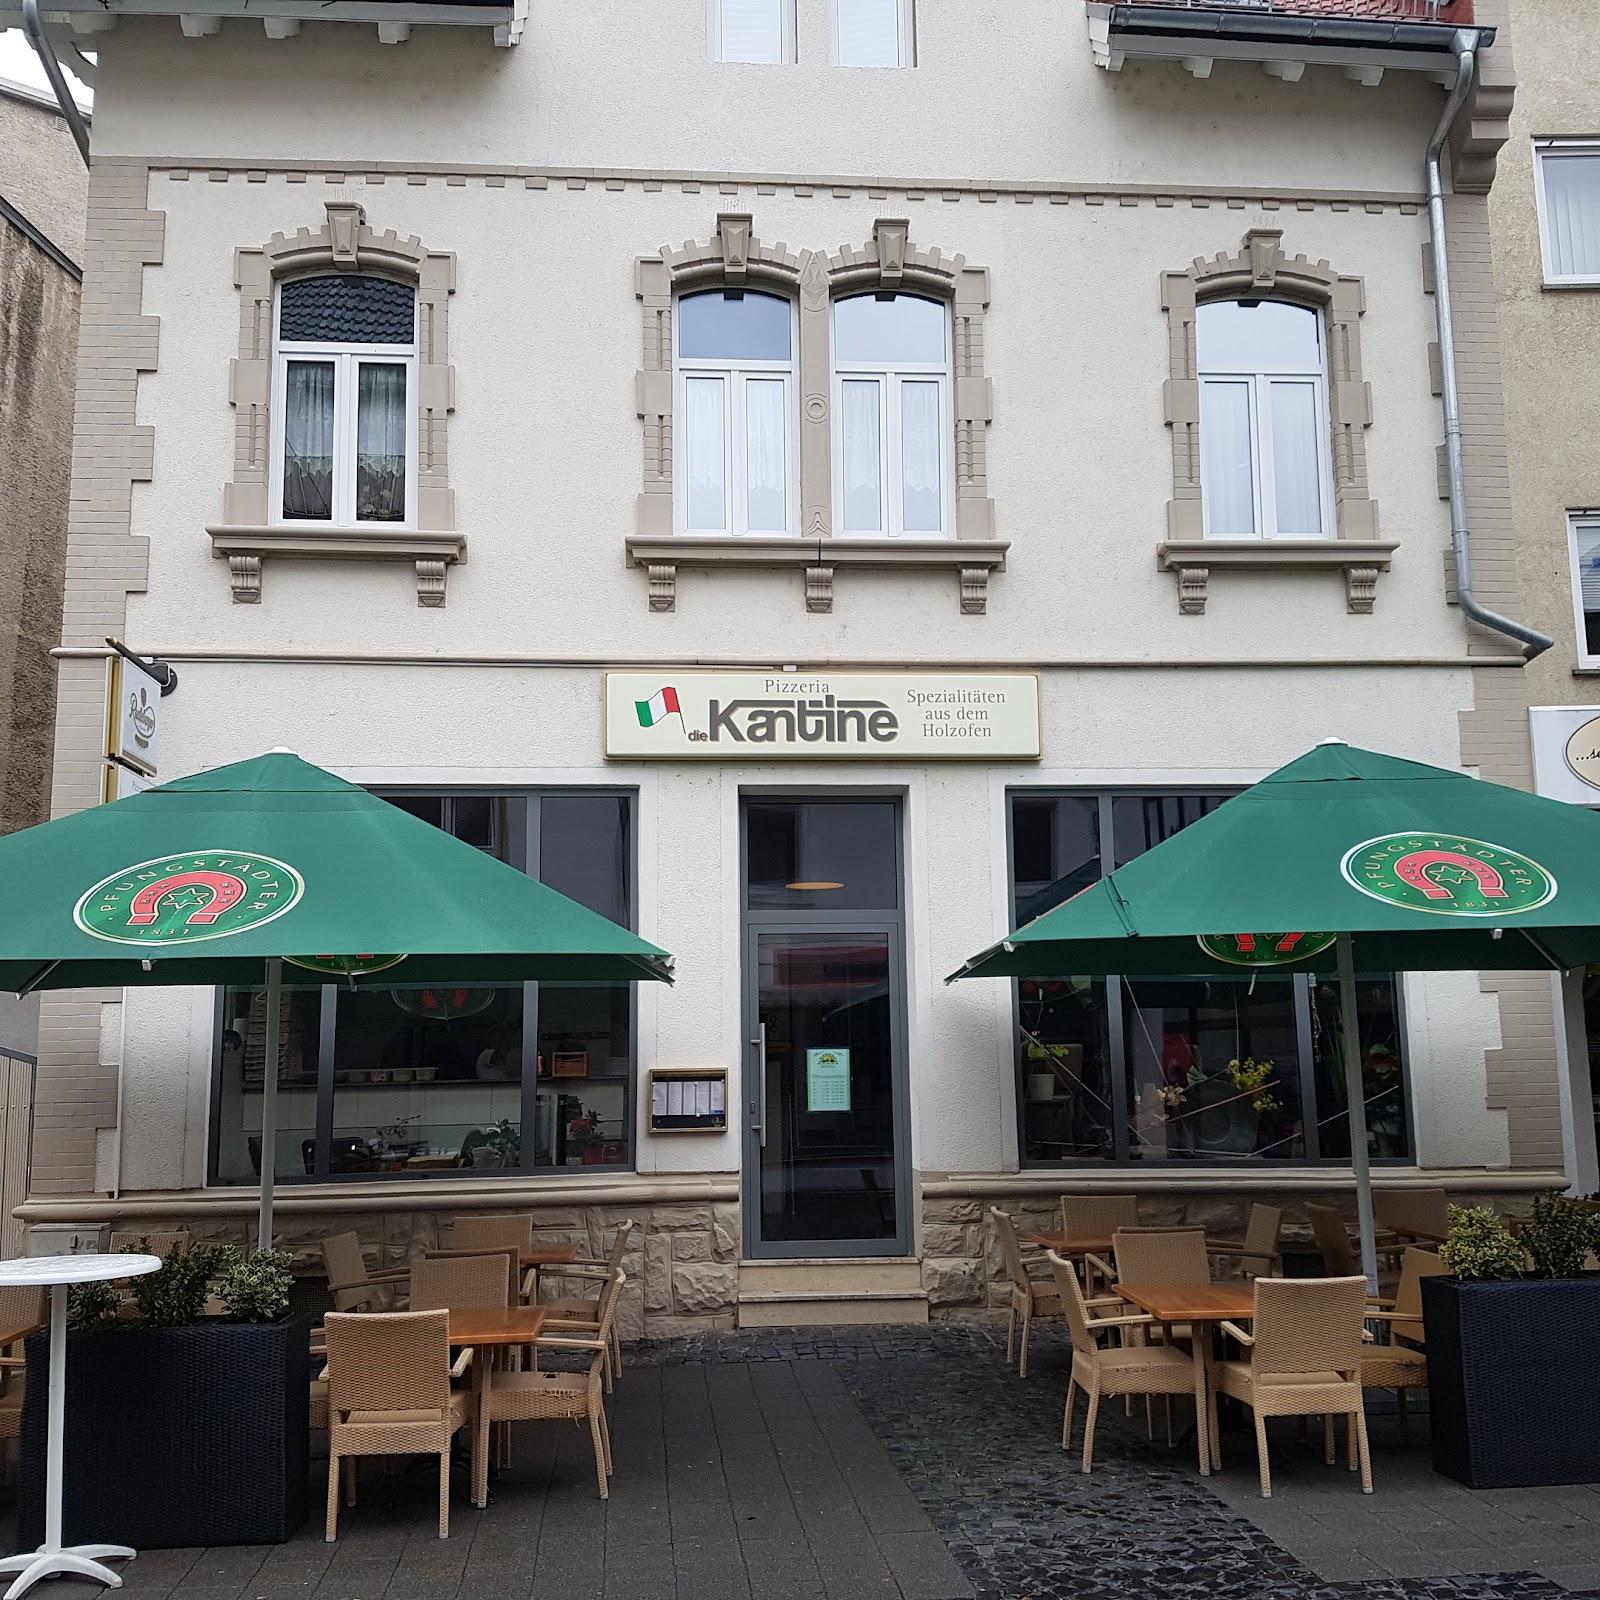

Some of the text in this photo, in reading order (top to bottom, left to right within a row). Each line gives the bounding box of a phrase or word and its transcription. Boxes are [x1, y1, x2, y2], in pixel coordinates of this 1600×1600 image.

[764, 679, 830, 694] Pizzeria
[906, 689, 1006, 707] Spezialitäten
[688, 694, 899, 743] die Kantine
[925, 705, 989, 721] aus dem
[922, 722, 992, 738] Holzofen
[1364, 840, 1533, 890] PFUNGSTÄDTER
[100, 859, 280, 912] PFUNGSTÄDTER
